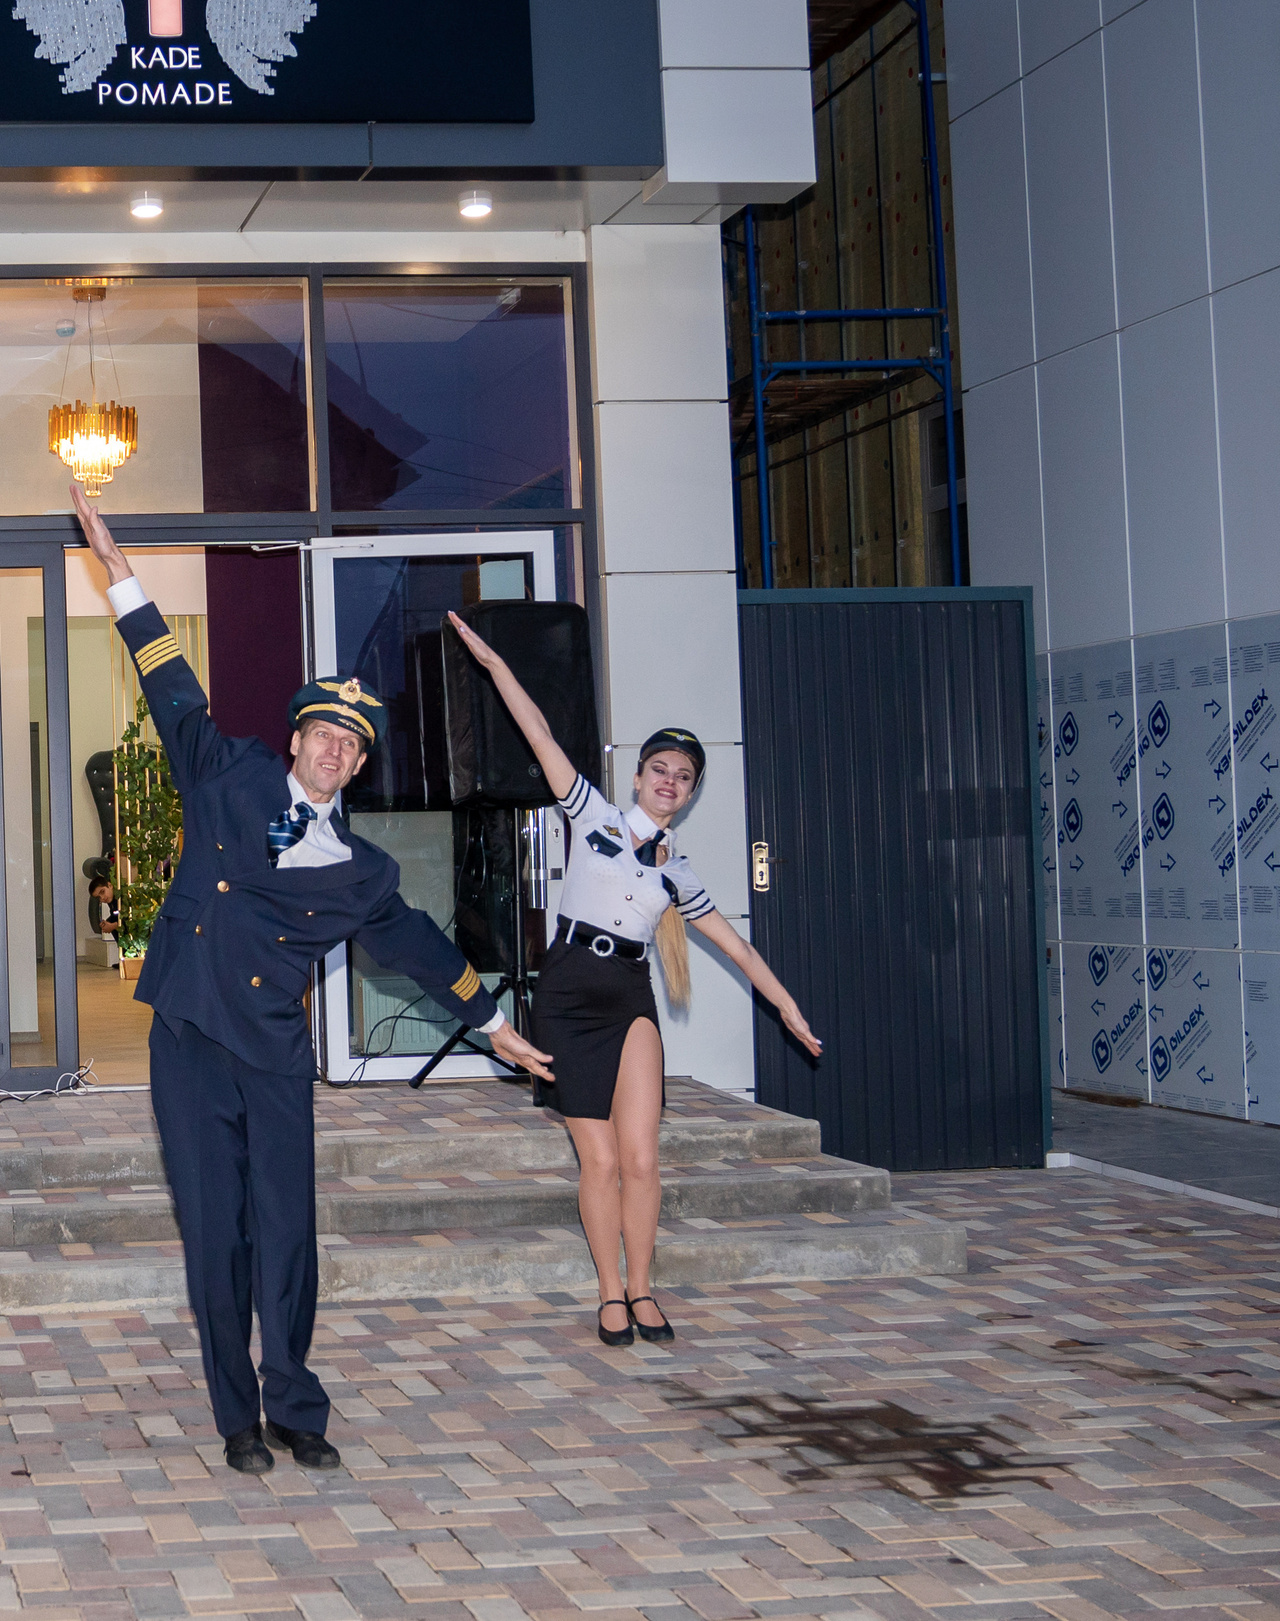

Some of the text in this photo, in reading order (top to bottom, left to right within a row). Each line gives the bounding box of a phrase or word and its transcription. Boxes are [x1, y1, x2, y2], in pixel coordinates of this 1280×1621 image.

[130, 46, 202, 70] KADE
[98, 82, 233, 105] POMADE
[1111, 998, 1143, 1044] BILDEX
[1169, 1003, 1205, 1051] BILDEX
